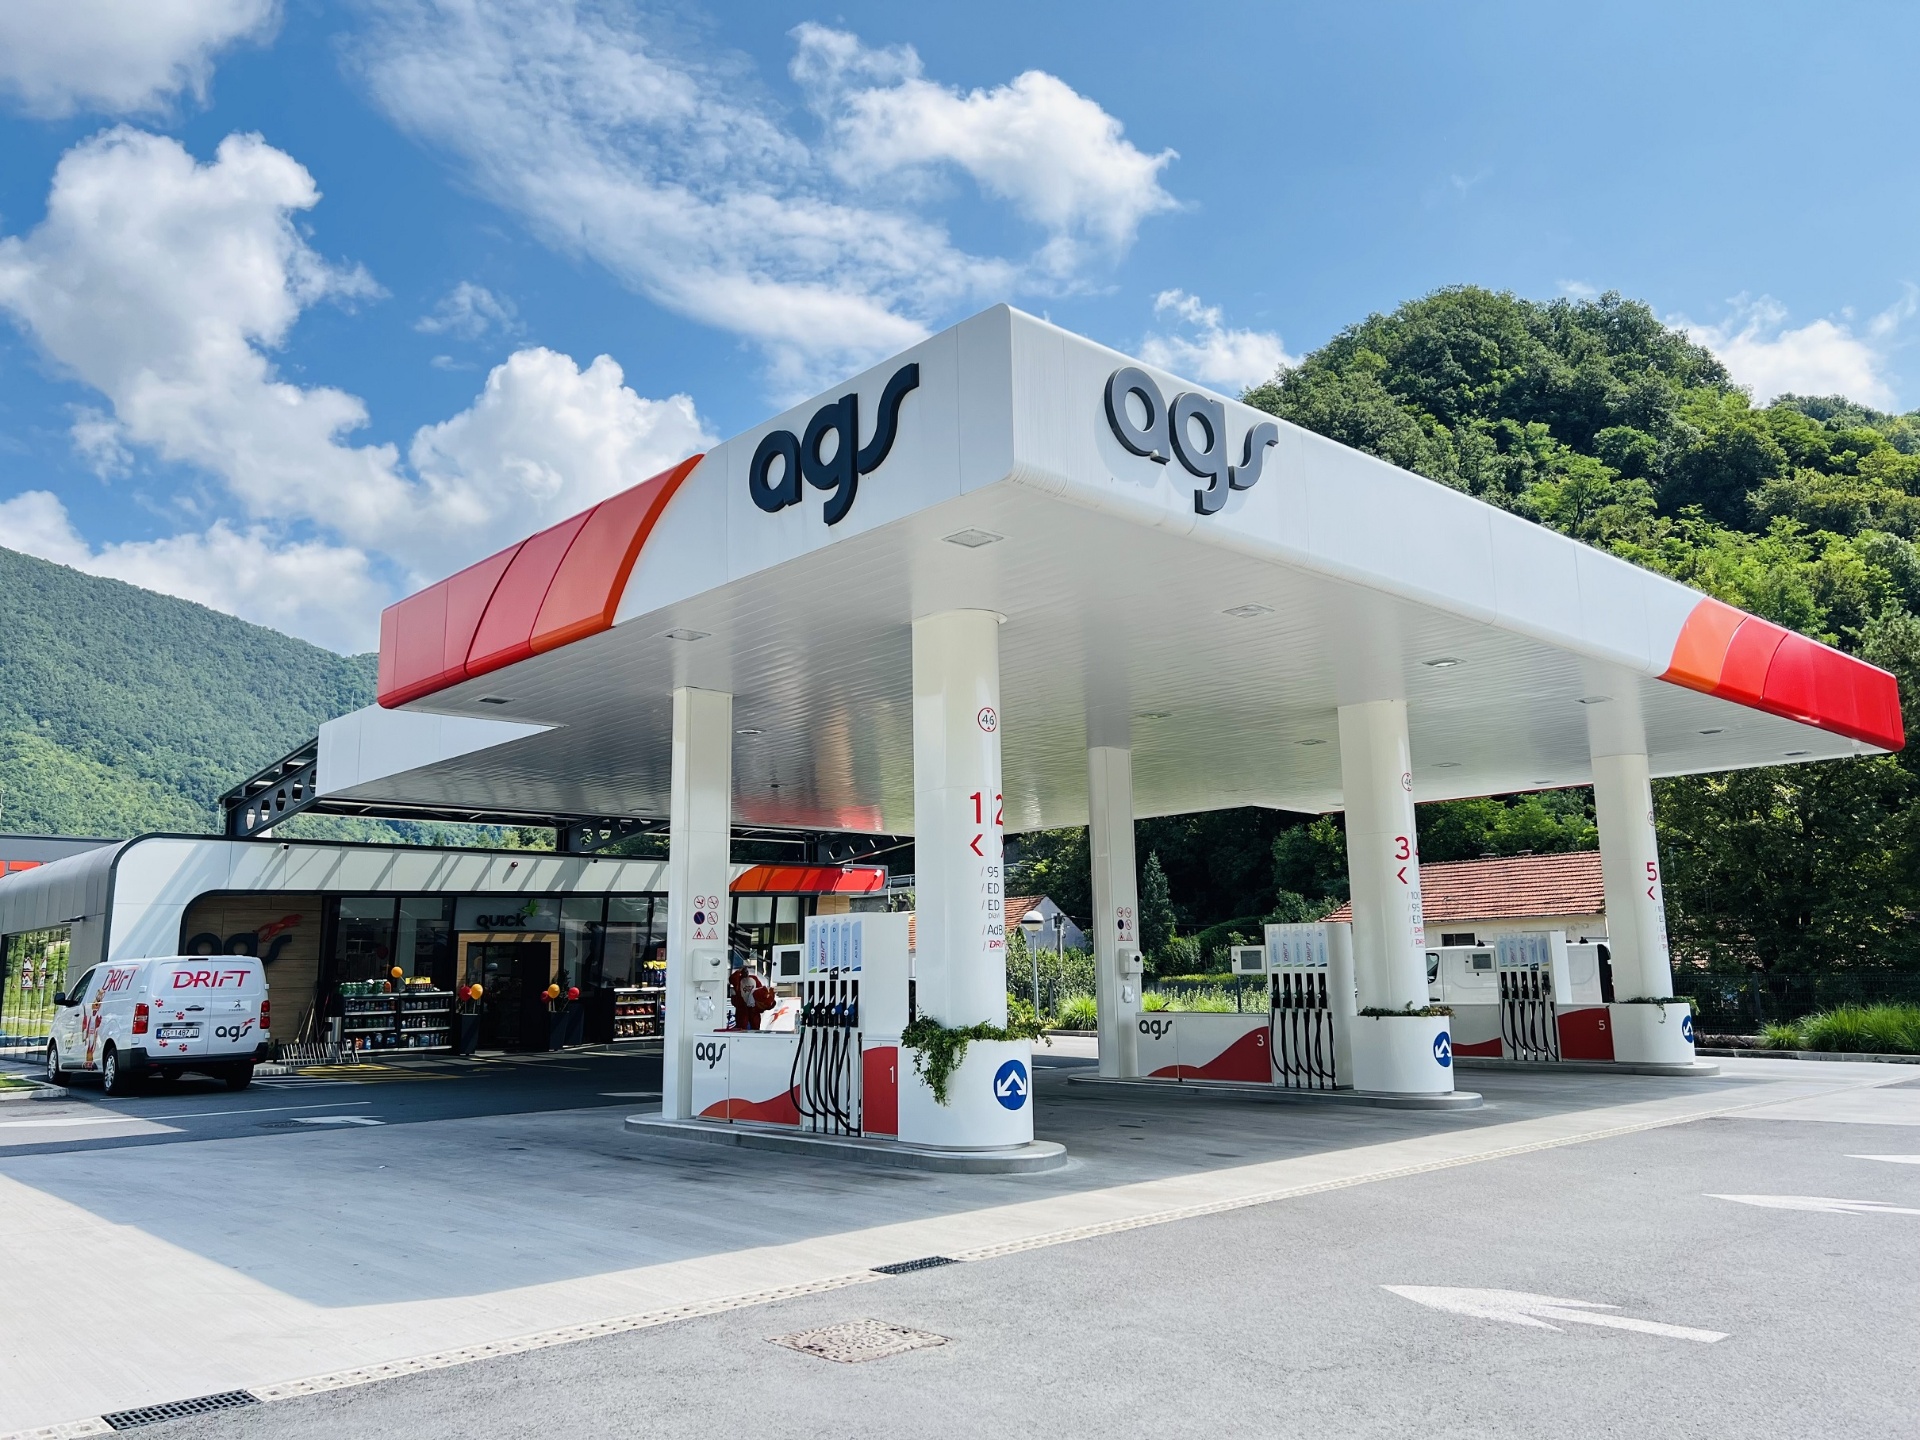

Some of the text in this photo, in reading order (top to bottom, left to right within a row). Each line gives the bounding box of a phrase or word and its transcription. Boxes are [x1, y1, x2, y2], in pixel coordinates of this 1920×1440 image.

[749, 362, 919, 526] ags
[1104, 366, 1279, 515] ags
[969, 791, 982, 825] 1
[1394, 836, 1411, 861] 3
[987, 866, 999, 878] 95
[1646, 861, 1658, 882] 5
[987, 882, 1000, 894] ED
[987, 899, 1000, 911] ED
[102, 966, 140, 992] DRIFT
[172, 970, 251, 989] DRIFT
[215, 1025, 252, 1043] ags
[1138, 1019, 1173, 1041] ags
[1598, 1019, 1606, 1031] 5
[1256, 1034, 1265, 1047] 3
[695, 1041, 726, 1070] ags
[889, 1065, 895, 1084] 1
